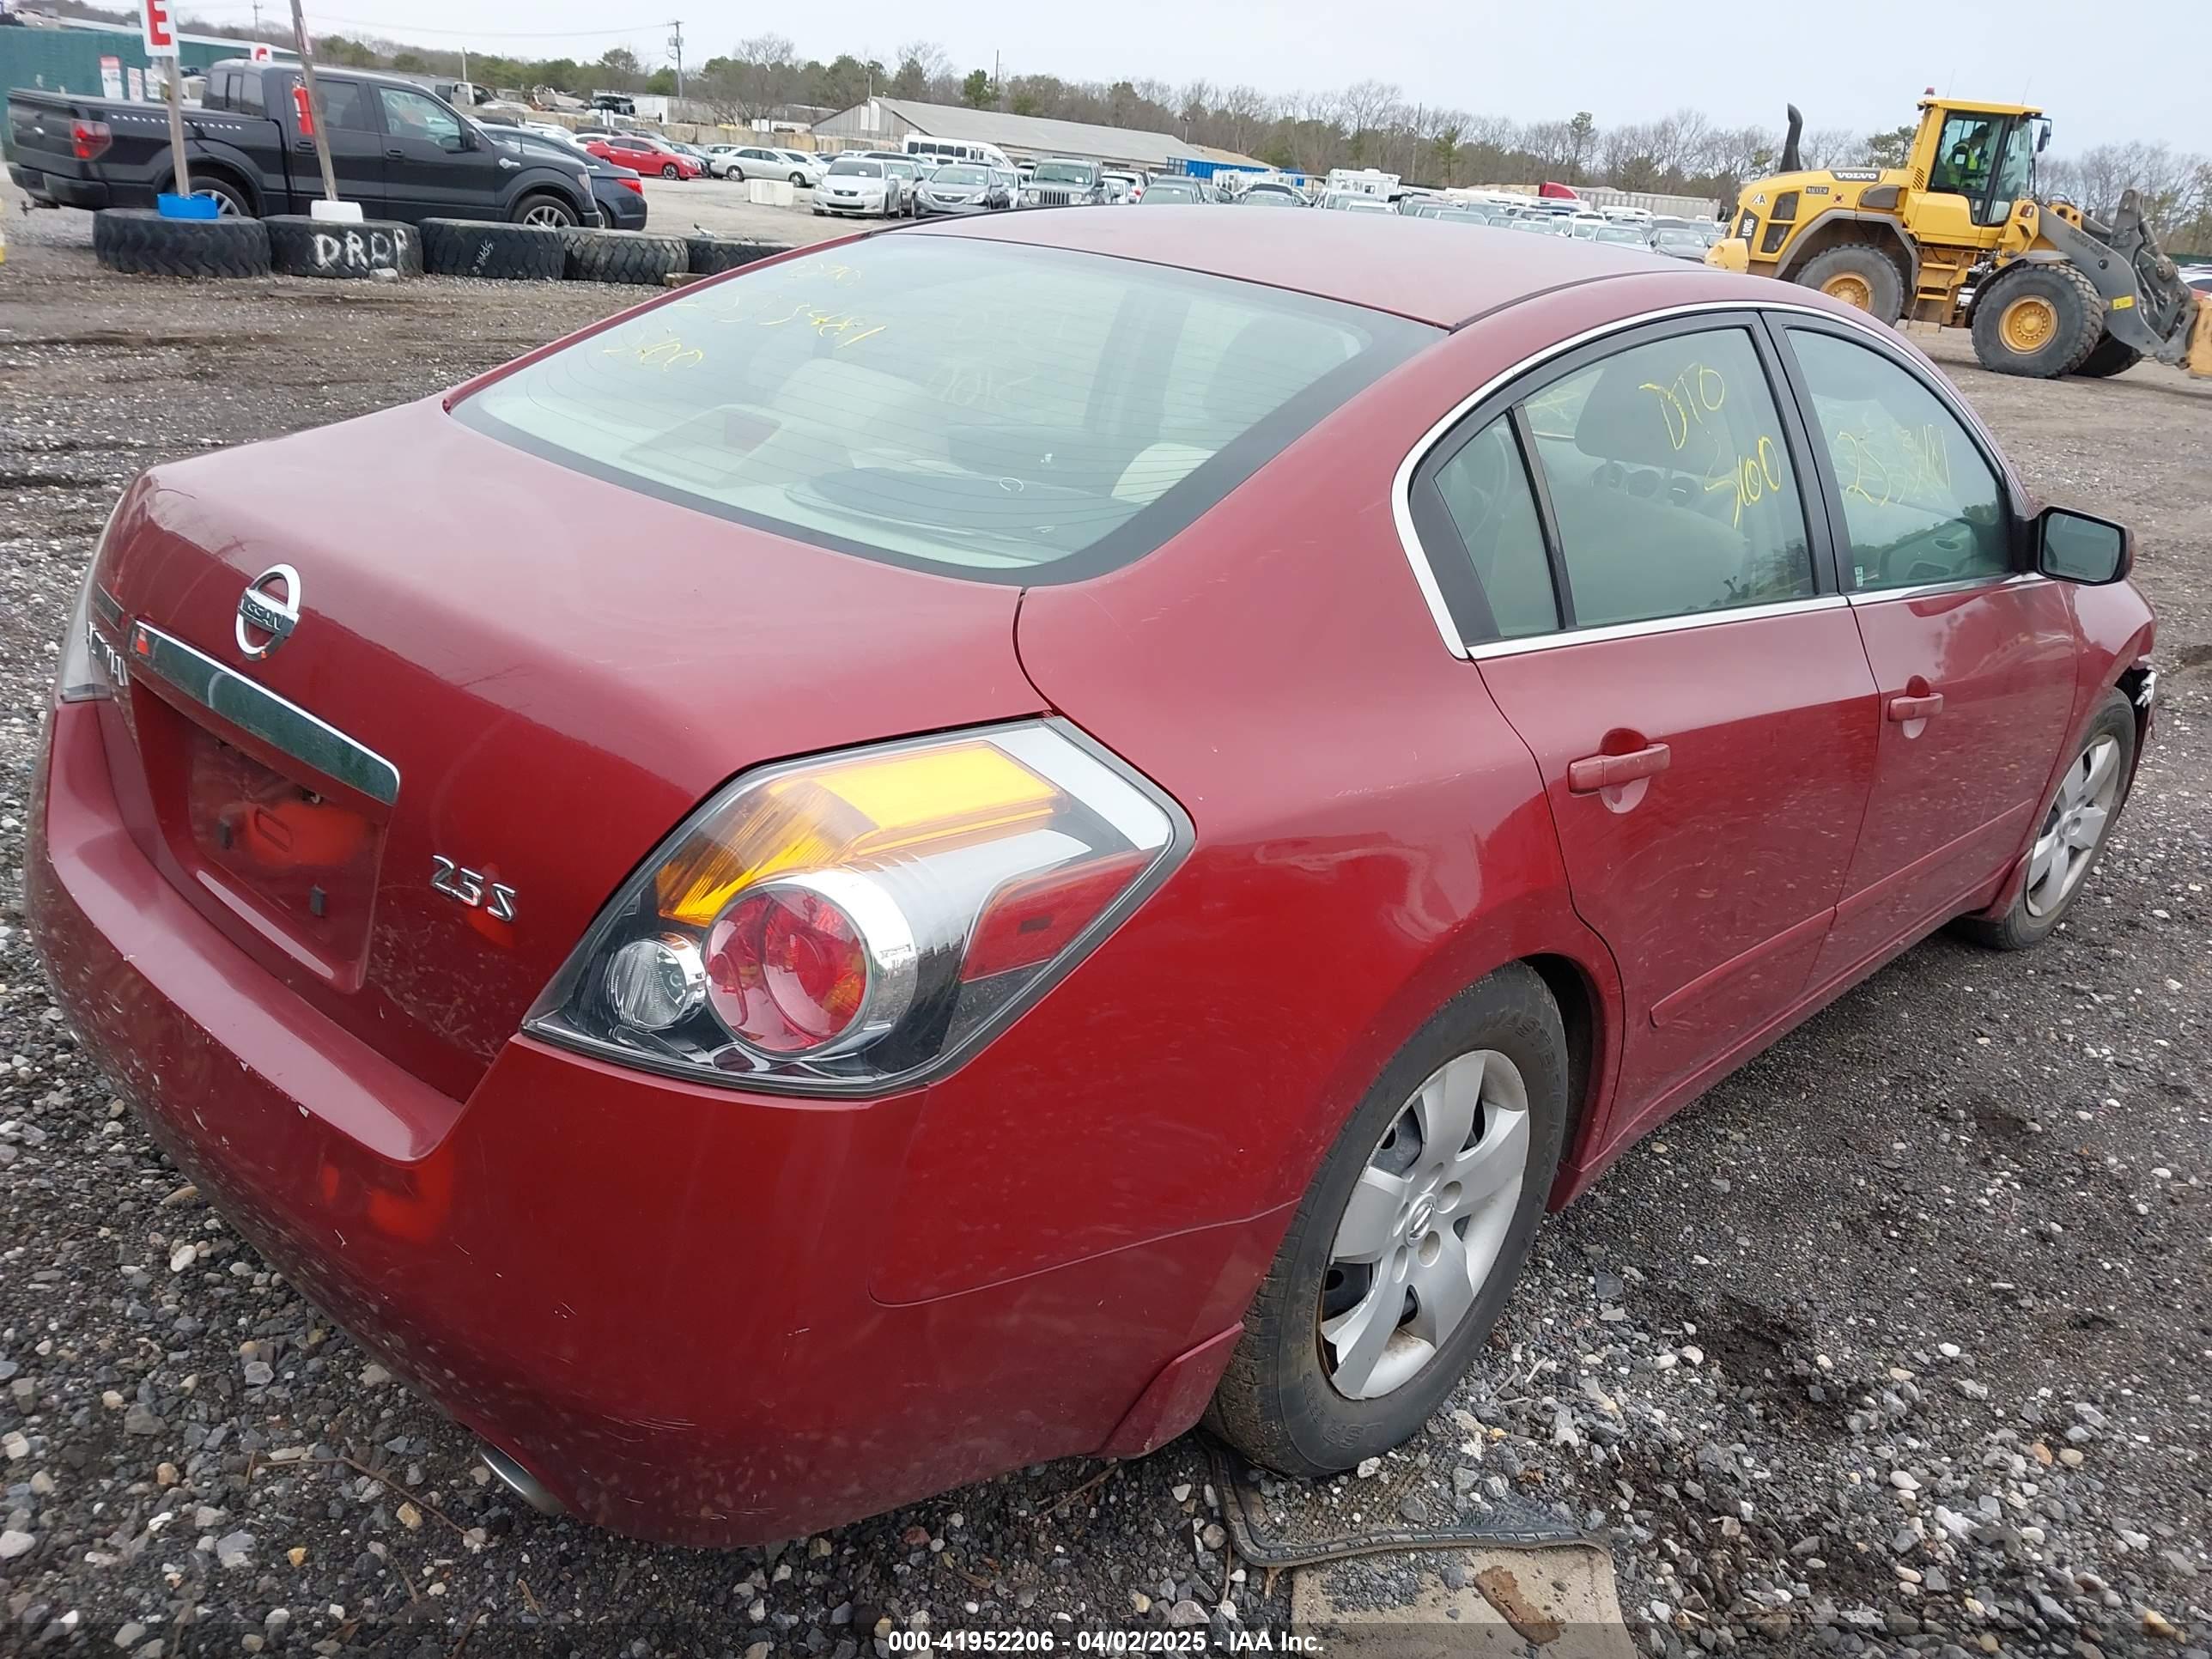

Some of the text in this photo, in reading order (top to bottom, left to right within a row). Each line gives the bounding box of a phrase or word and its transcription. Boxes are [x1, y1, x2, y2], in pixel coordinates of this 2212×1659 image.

[1836, 172, 1877, 180] VOLVO
[1742, 218, 1755, 237] L90G
[313, 228, 409, 269] DROP
